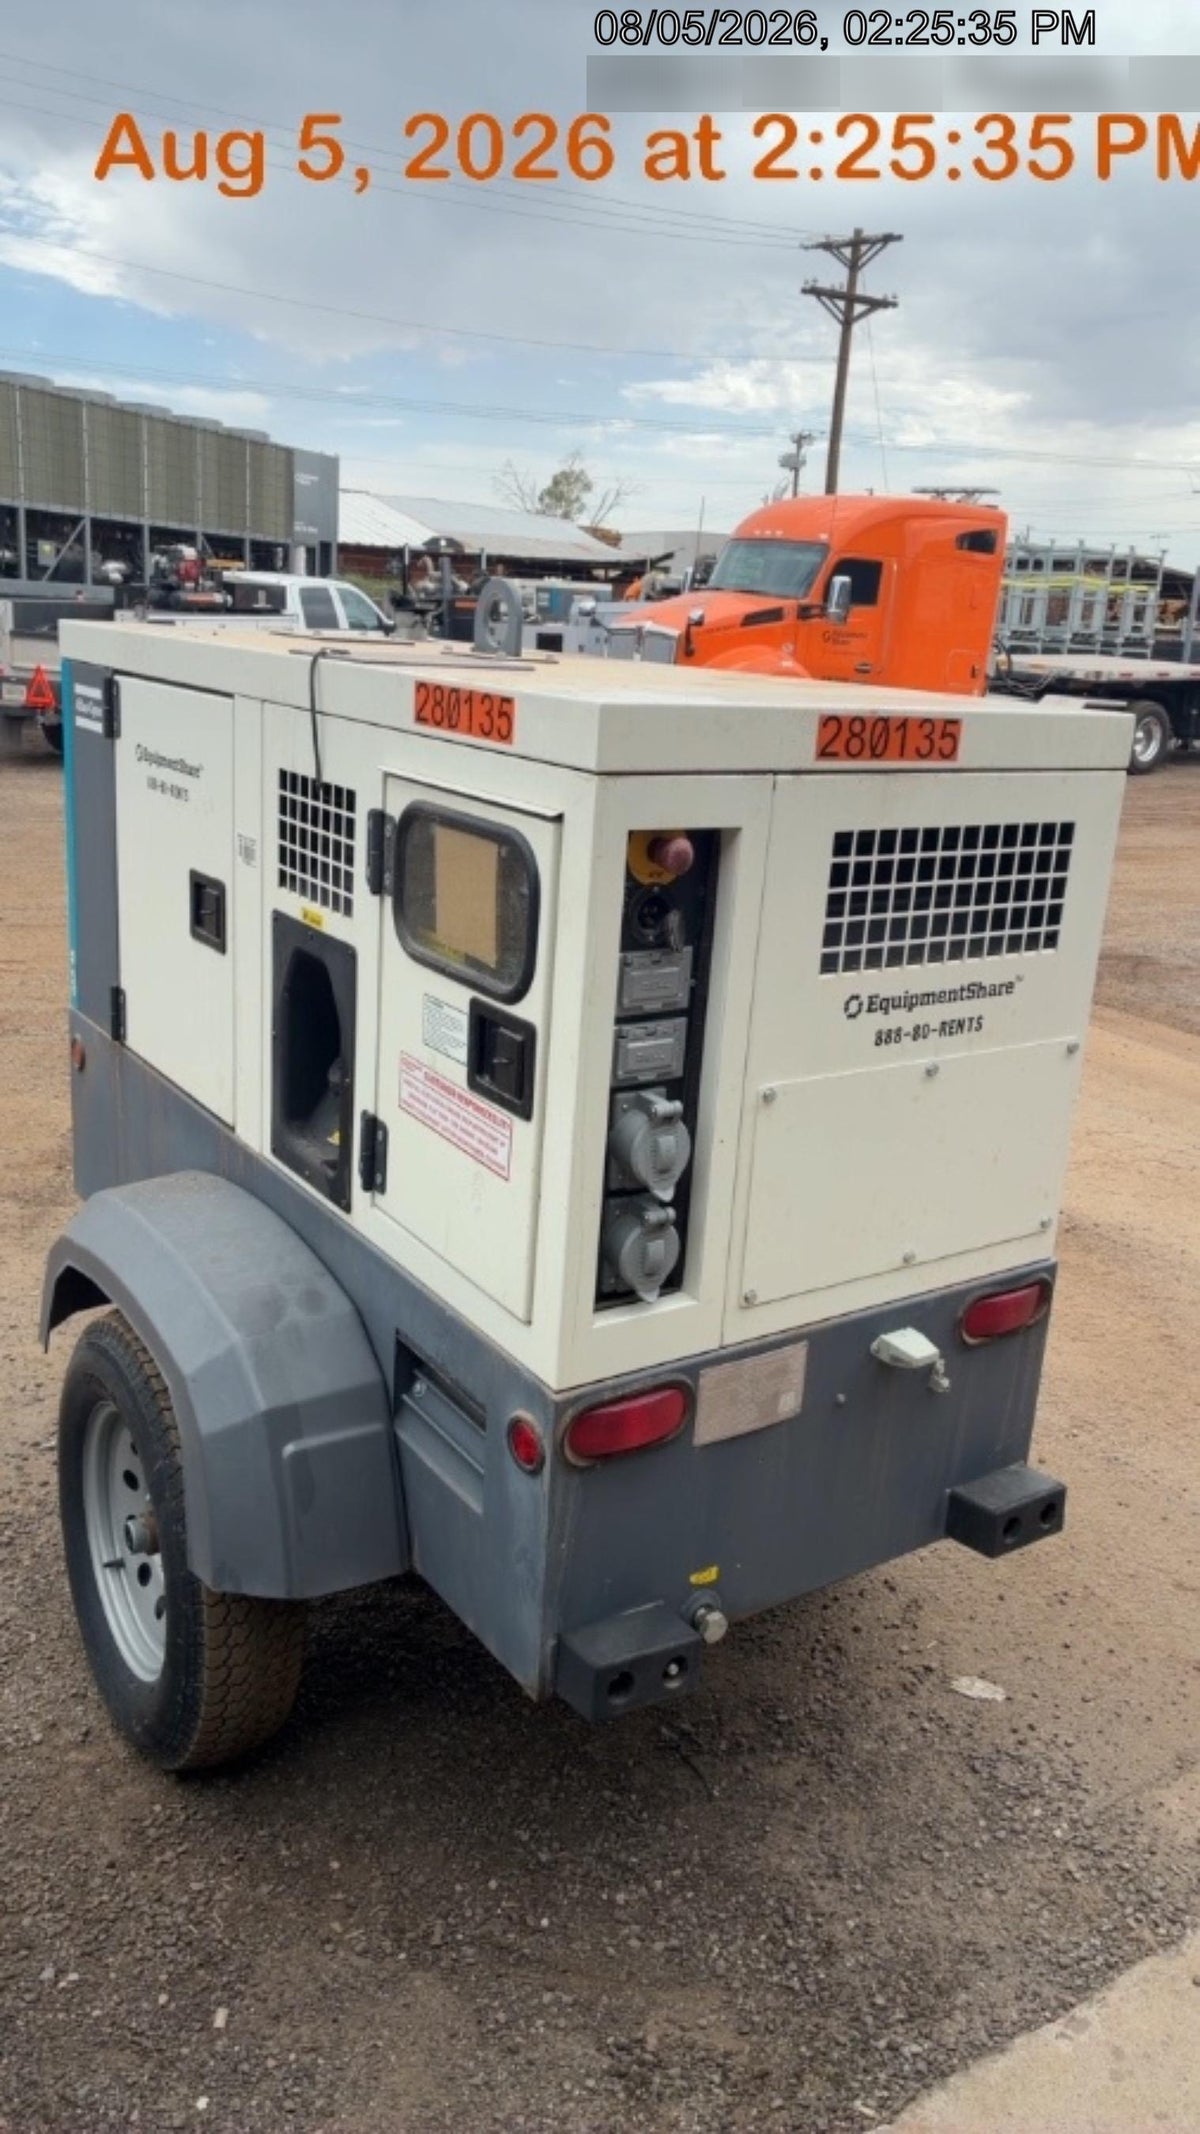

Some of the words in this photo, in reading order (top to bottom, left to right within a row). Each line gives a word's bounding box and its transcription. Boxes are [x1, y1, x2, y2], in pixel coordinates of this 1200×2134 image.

[415, 682, 514, 742] 280135
[818, 714, 960, 759] 280135
[865, 980, 1016, 1016] EquipmentShare
